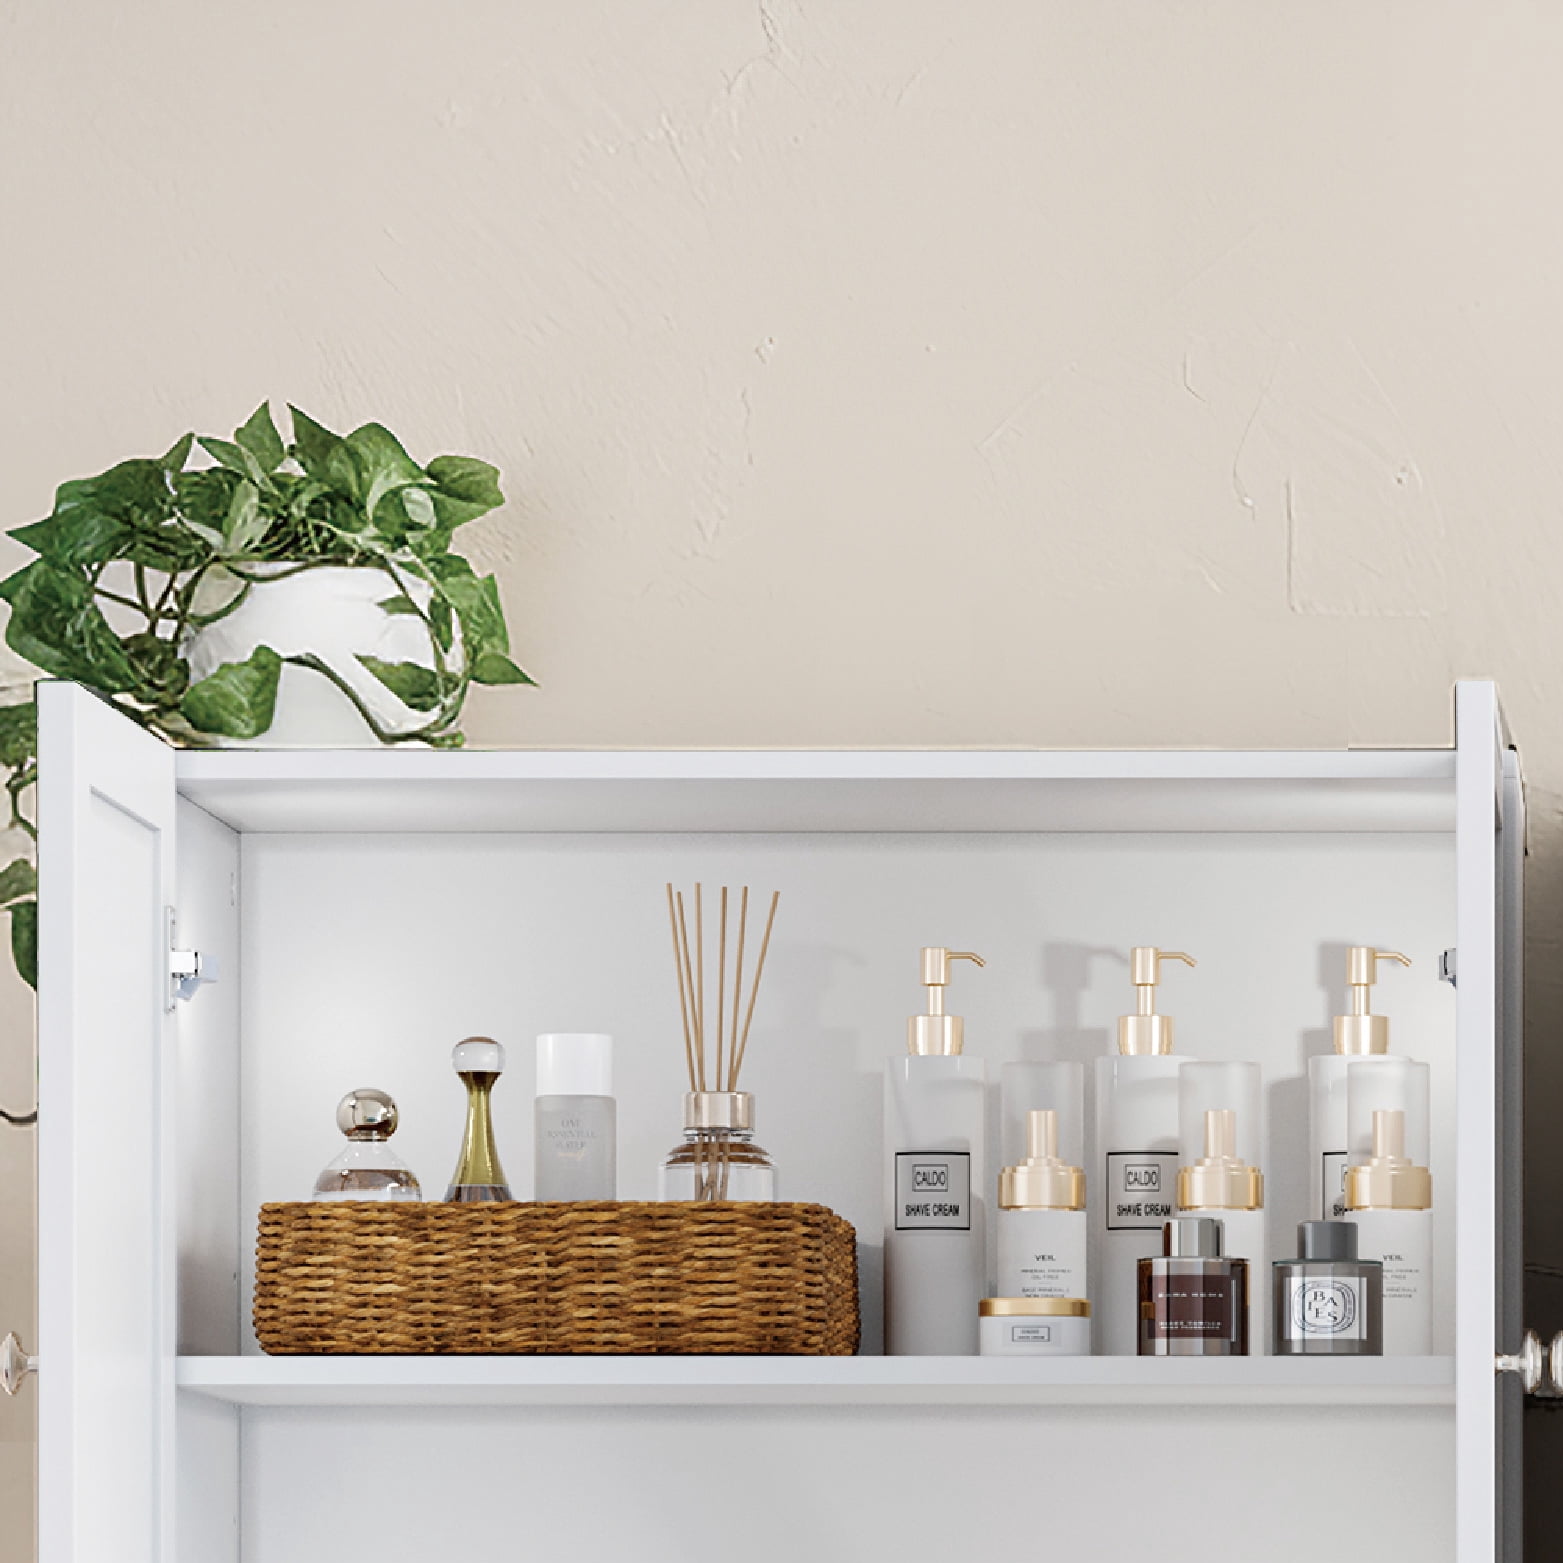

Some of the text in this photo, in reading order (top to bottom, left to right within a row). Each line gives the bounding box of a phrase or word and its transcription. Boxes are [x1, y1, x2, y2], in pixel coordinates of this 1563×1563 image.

[915, 1170, 946, 1187] CALDO
[1127, 1170, 1158, 1187] CALDO
[905, 1203, 960, 1217] SHAVE CREAM
[1116, 1203, 1171, 1217] SHAVE CREAM
